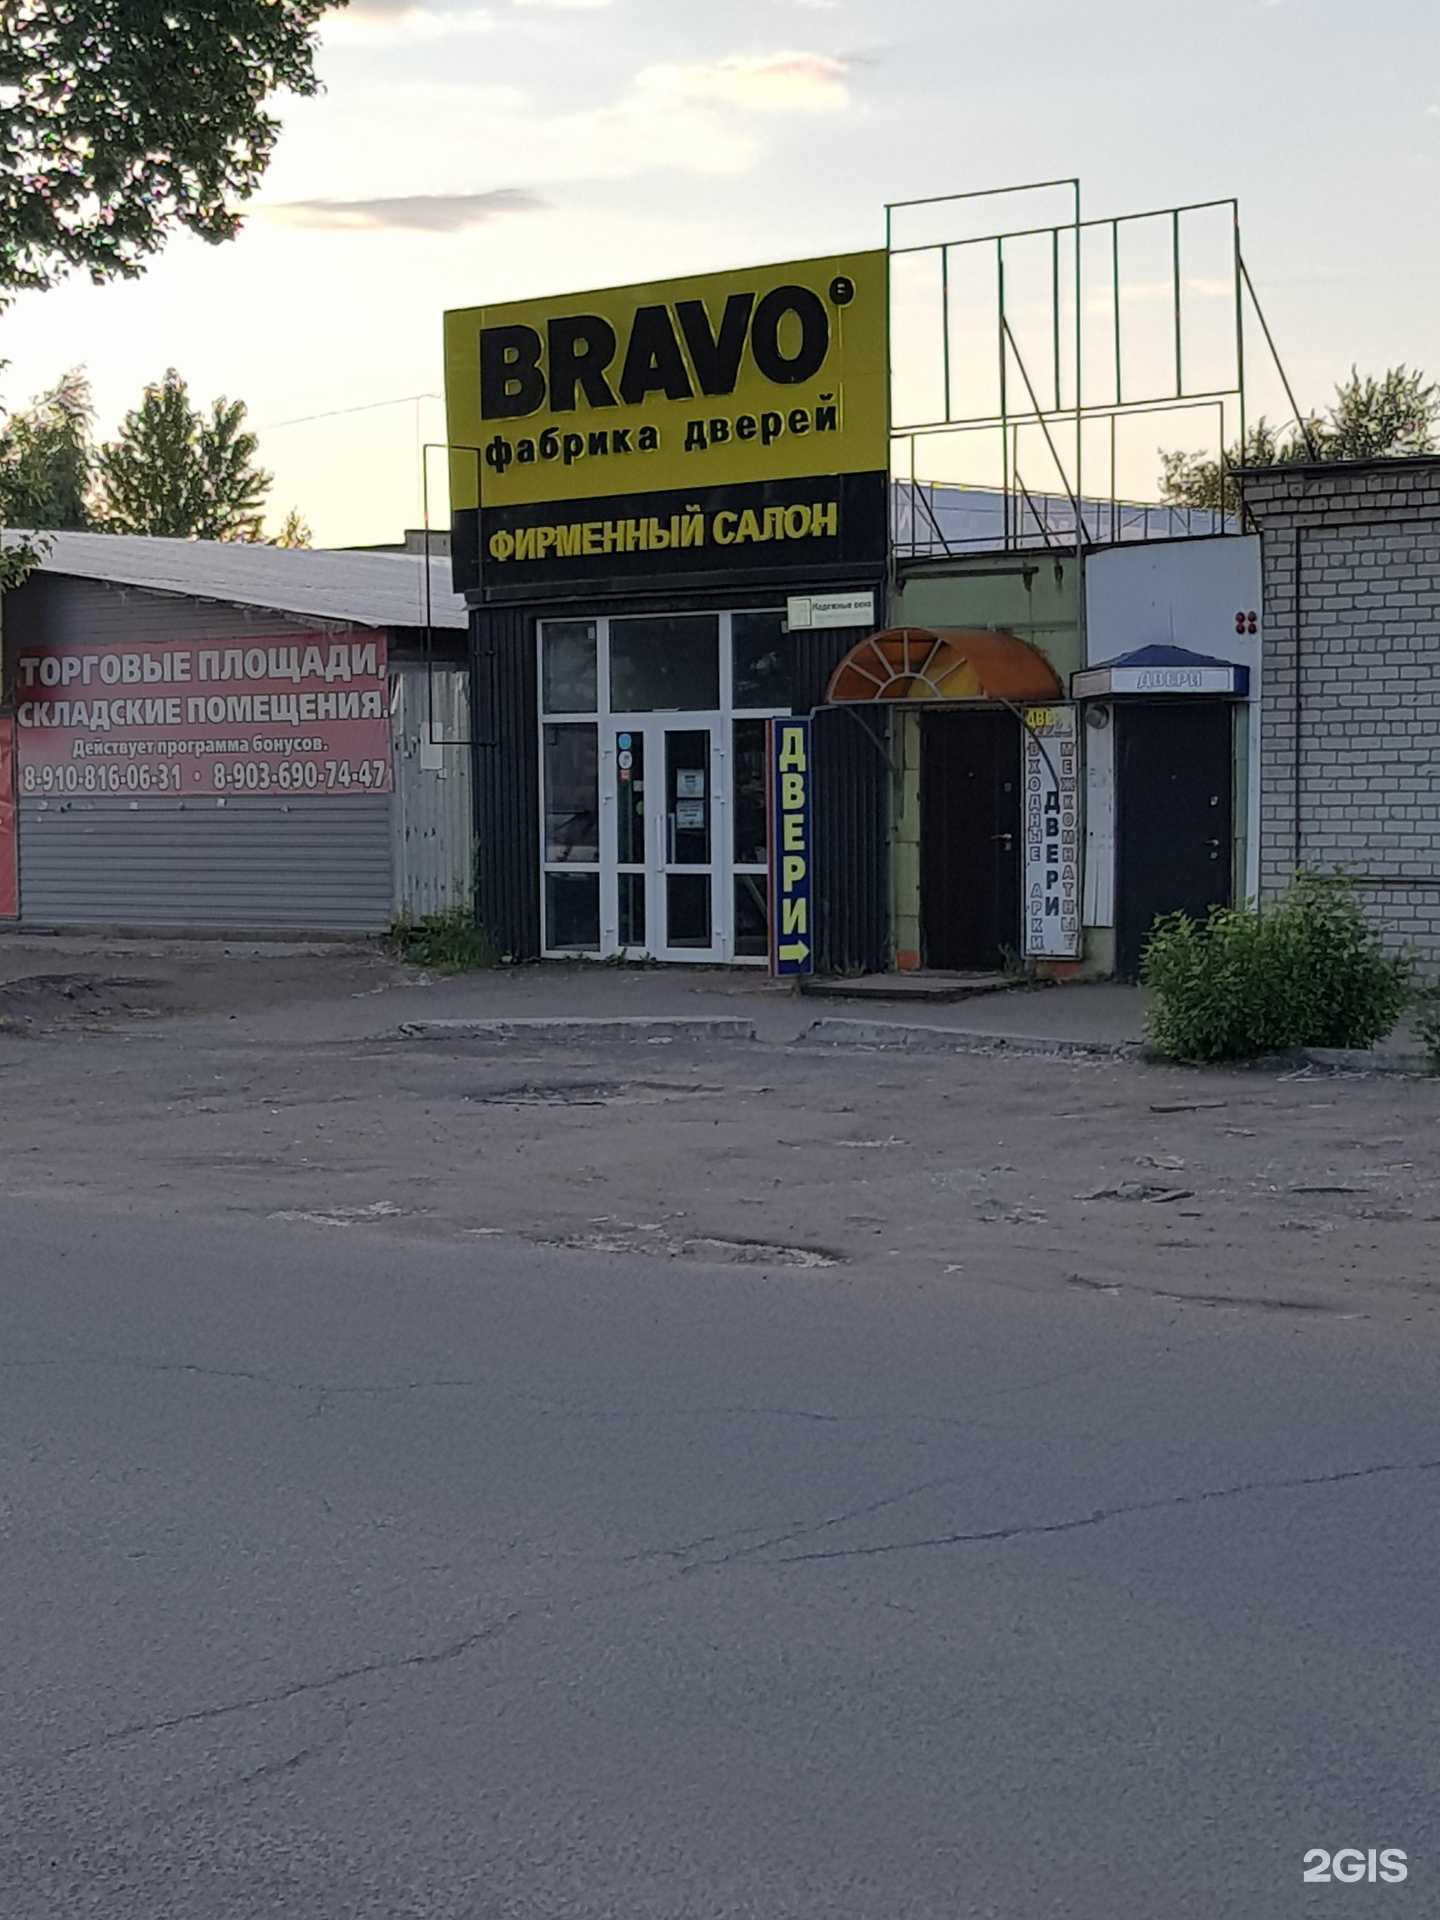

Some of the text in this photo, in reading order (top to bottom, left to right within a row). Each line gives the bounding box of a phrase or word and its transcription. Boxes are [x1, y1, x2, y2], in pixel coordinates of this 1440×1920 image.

[480, 285, 829, 421] BRAVO
[485, 393, 838, 472] фабрика дверей
[489, 502, 838, 561] ФИРМЕННЫЙ САЛОН
[19, 643, 386, 687] ТОРГОВЫЕ ПЛОЩАДИ,
[1137, 672, 1202, 688] ДВЕРИ
[17, 691, 390, 731] СКЛАДСКИЕ ПОМЕЩЕНИЯ.
[23, 760, 386, 791] 8-910-816-06-31 8-903-690-74-47
[72, 735, 328, 758] Действует программа бонусов.
[779, 728, 807, 934] ДВЕРИ
[1028, 742, 1043, 861] ВХОДНЫЕ
[1044, 791, 1061, 917] ДВЕРИ
[1031, 883, 1043, 950] АРКИ
